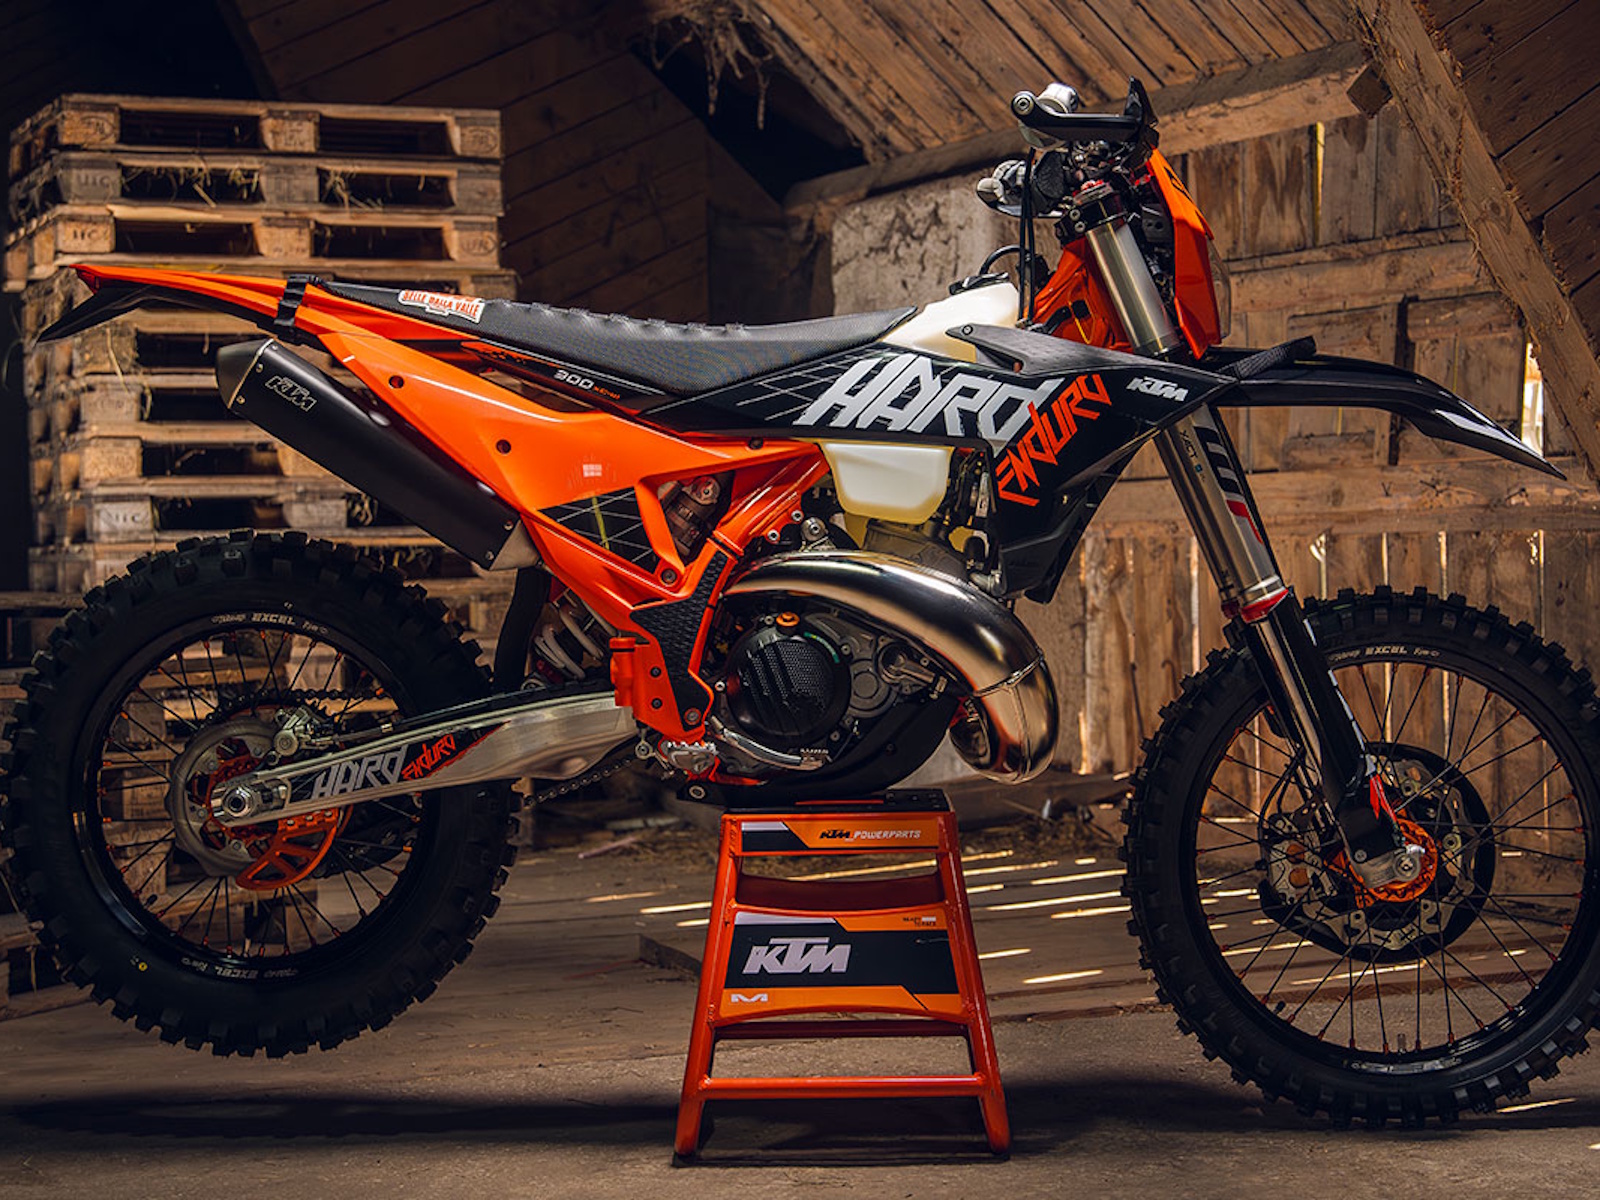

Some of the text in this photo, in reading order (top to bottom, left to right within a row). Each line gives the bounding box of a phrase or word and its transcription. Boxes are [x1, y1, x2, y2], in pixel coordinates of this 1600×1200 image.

[554, 369, 595, 390] 300
[1126, 376, 1189, 402] KTM
[264, 375, 318, 411] KTM
[793, 353, 1113, 507] HARD ENDURO
[251, 612, 297, 626] EXCEL
[1364, 645, 1408, 656] EXCEL
[310, 744, 409, 801] HARD
[820, 828, 922, 840] KTM POWERPARTS
[742, 937, 851, 974] KTM
